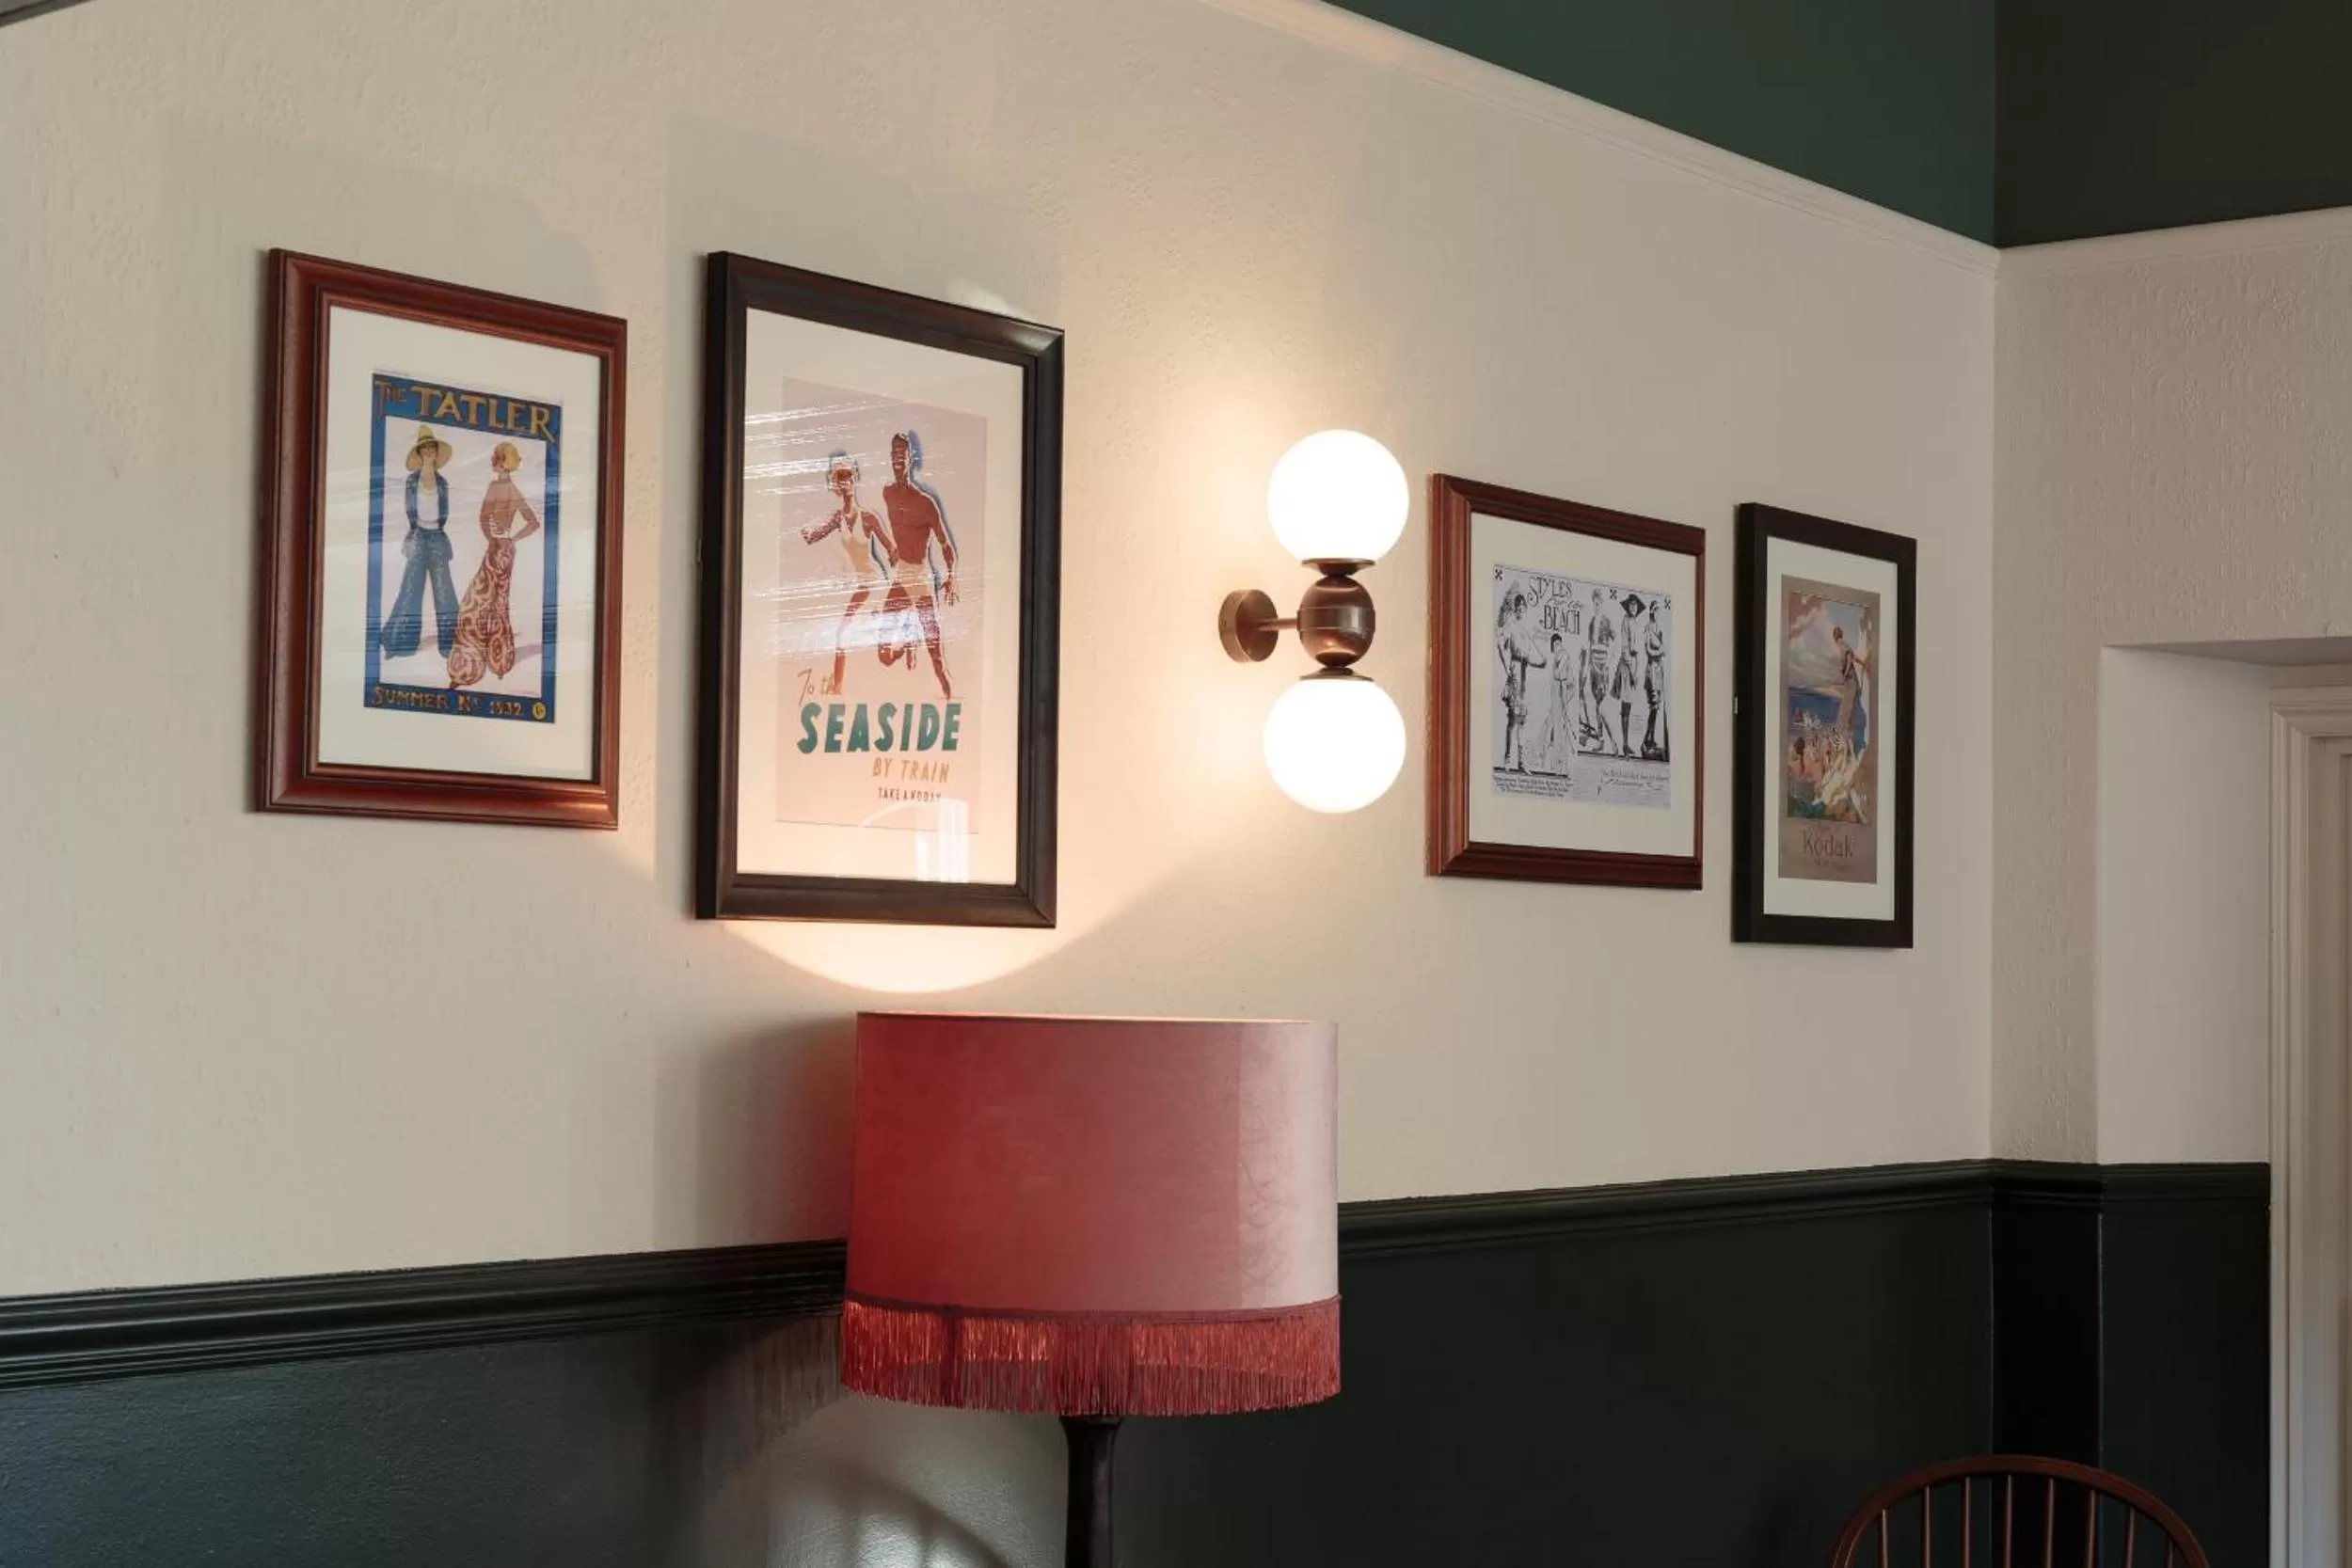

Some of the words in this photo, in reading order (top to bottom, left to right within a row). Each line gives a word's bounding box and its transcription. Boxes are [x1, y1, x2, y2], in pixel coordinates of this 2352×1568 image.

[411, 386, 556, 442] TATLER
[1527, 576, 1573, 607] STYLES
[1539, 604, 1581, 636] BEACH
[371, 686, 450, 710] SUMMER
[797, 668, 816, 707] To
[797, 703, 961, 754] SEASIDE
[871, 756, 894, 778] BY
[900, 759, 951, 784] TRAIN
[878, 785, 900, 801] TAKE
[1802, 828, 1853, 859] Kodak
